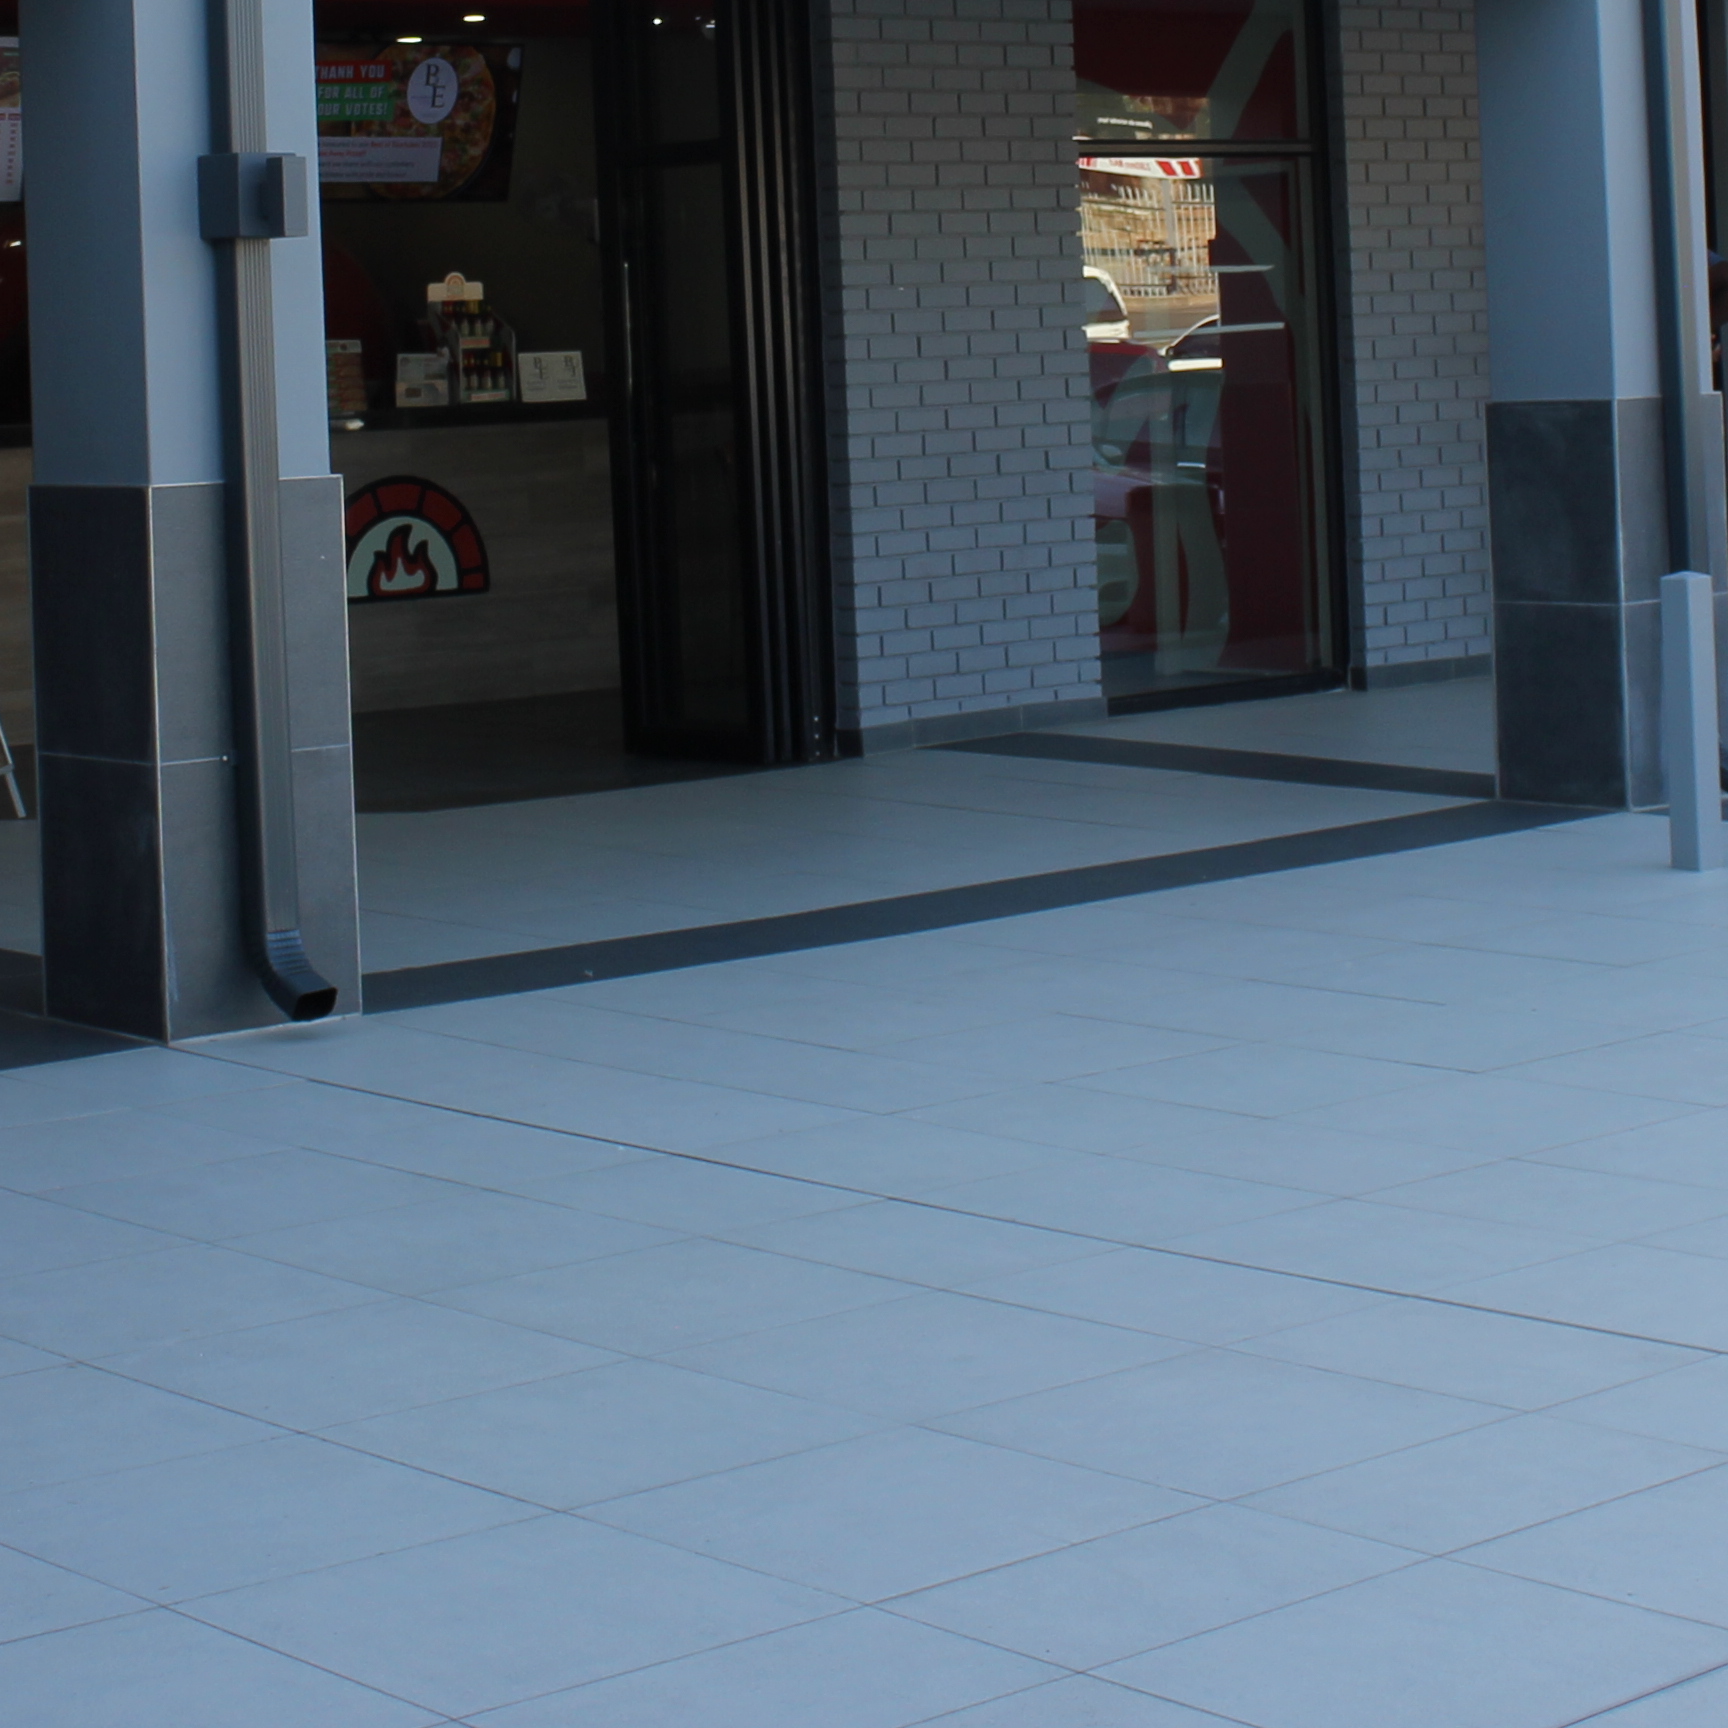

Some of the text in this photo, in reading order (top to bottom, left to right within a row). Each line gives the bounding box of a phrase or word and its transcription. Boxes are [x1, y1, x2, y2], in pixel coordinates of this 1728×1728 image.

[316, 63, 386, 80] THANK YOU
[318, 84, 384, 99] FOR ALL OF
[346, 102, 388, 116] VOTES!
